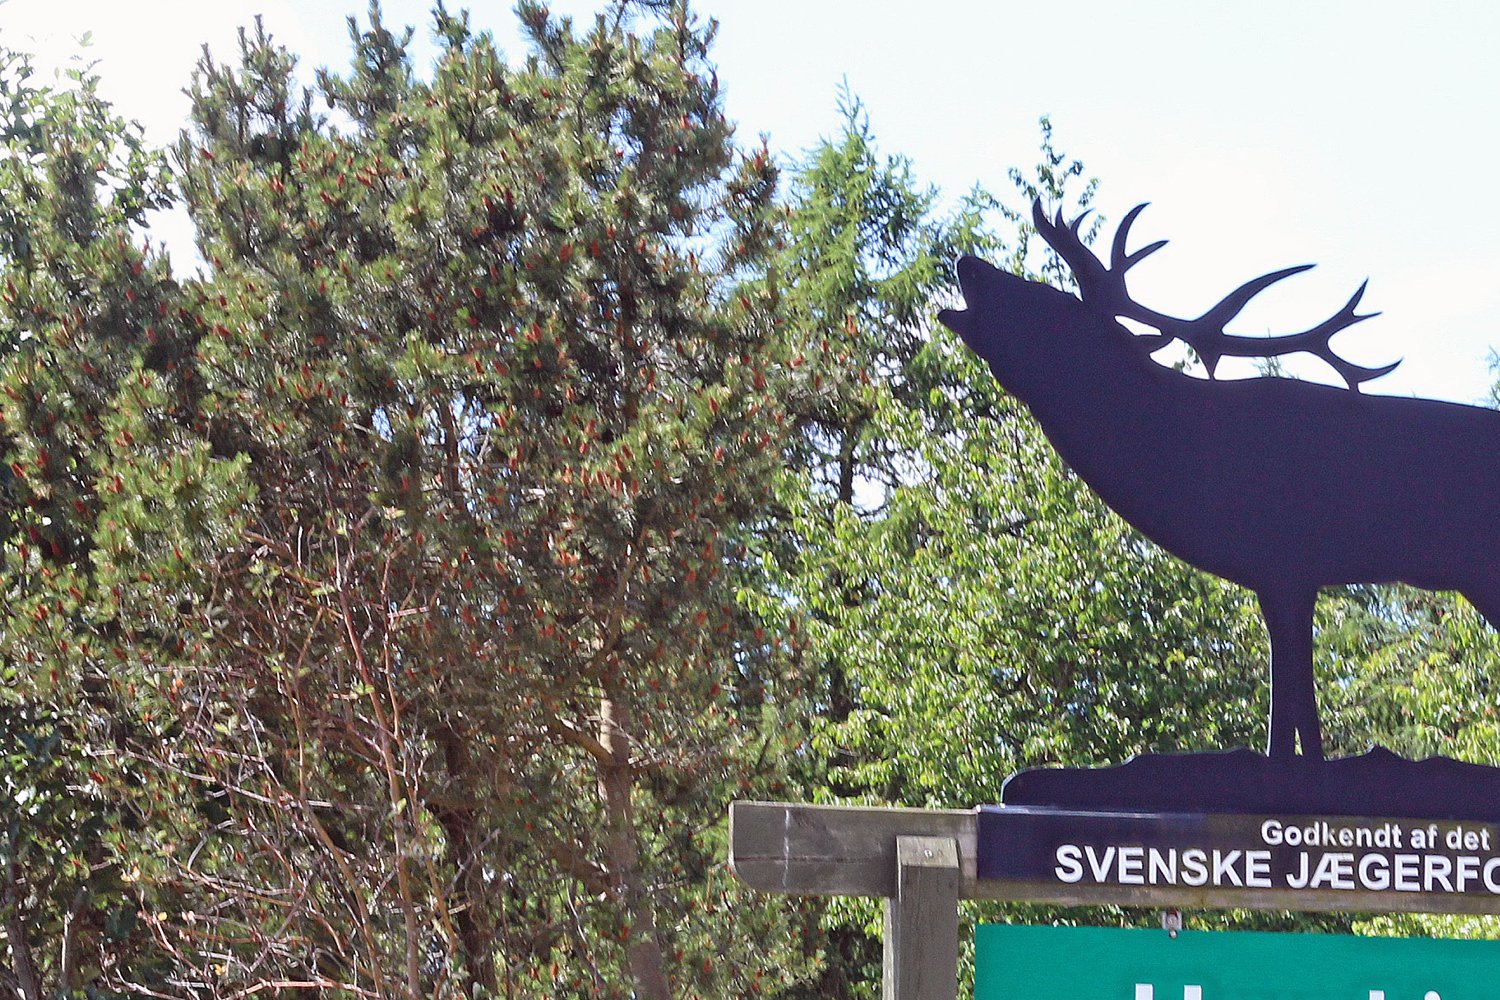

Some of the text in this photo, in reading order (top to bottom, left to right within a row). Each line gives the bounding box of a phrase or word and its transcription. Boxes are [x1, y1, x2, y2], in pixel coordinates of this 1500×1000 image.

[1260, 820, 1492, 851] Godkendt af det
[1054, 844, 1273, 888] SVENSKE
